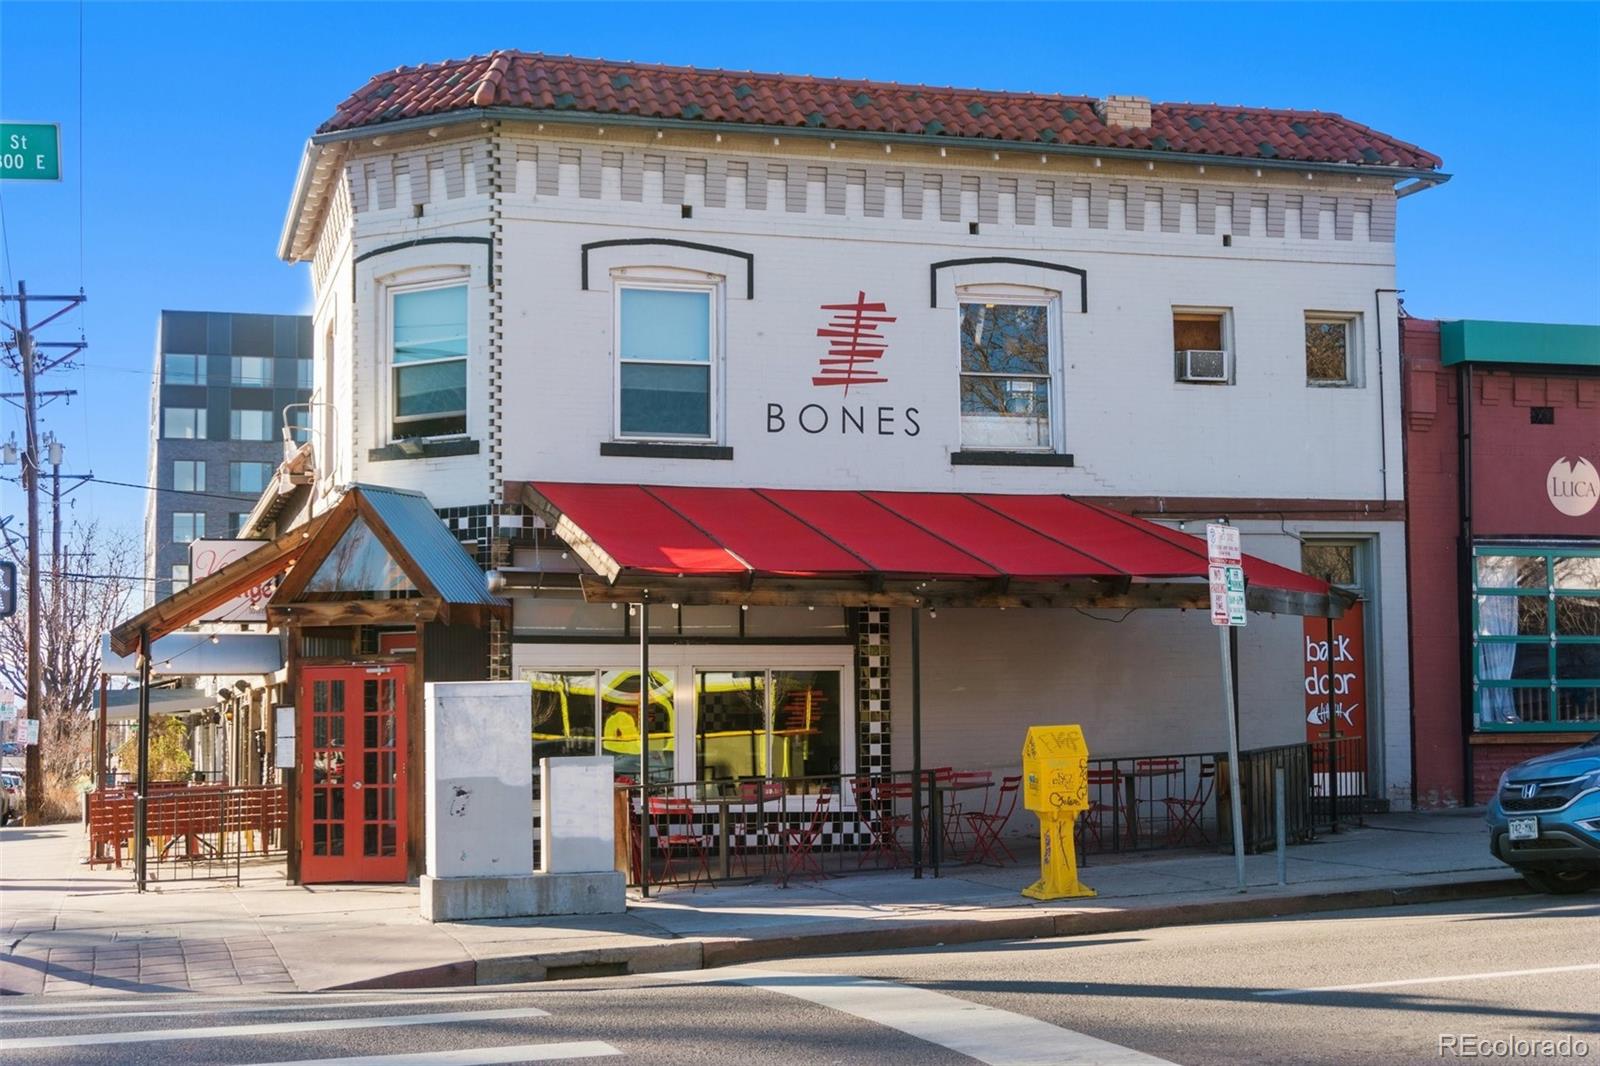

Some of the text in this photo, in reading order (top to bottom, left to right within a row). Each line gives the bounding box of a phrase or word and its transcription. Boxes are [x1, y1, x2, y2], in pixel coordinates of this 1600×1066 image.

[10, 134, 27, 150] St
[36, 154, 46, 170] E
[767, 403, 921, 437] BONES
[1552, 476, 1597, 498] LUCA
[1305, 634, 1354, 662] back
[1304, 666, 1357, 695] door
